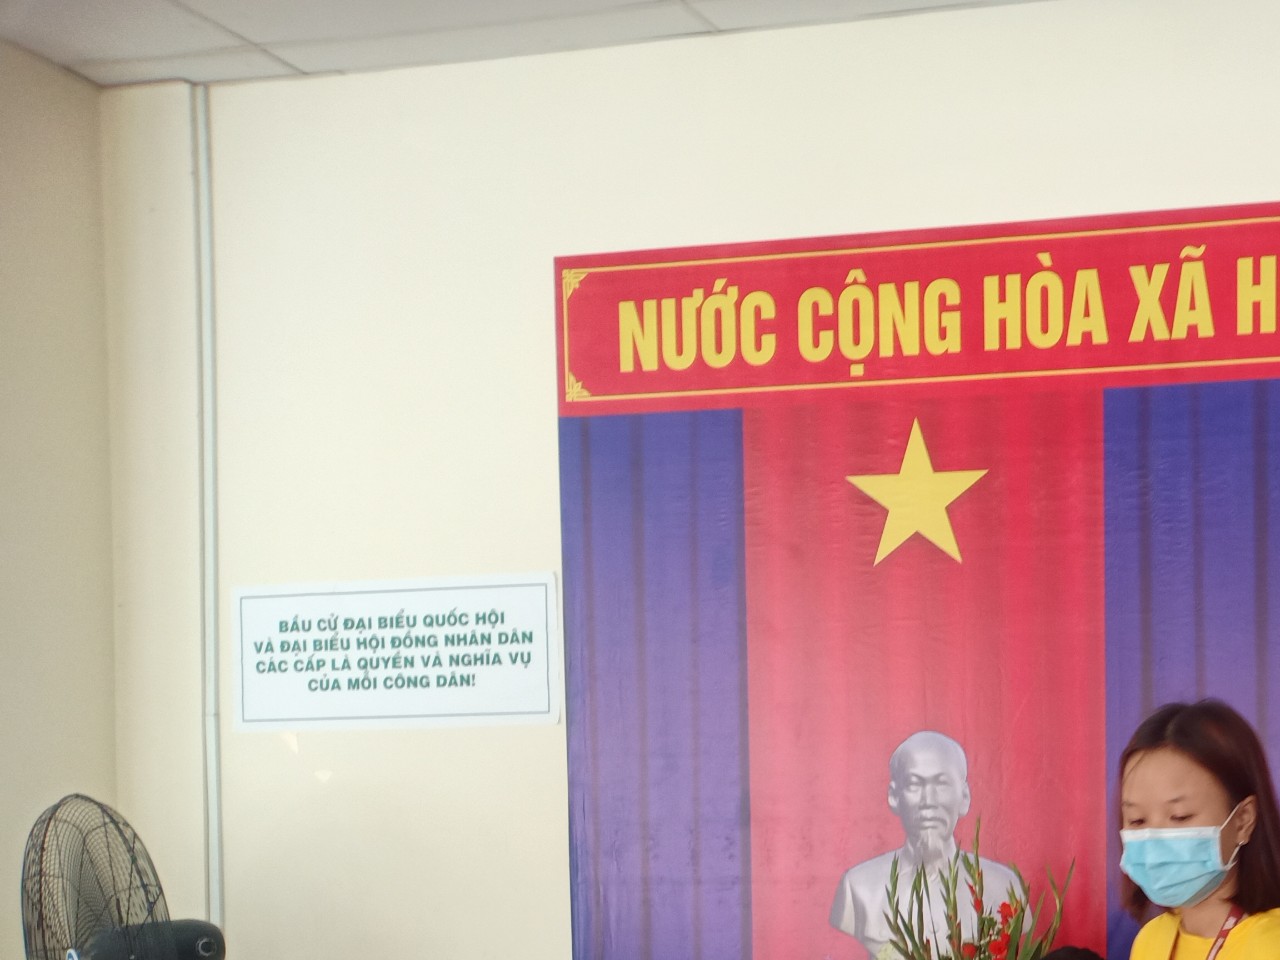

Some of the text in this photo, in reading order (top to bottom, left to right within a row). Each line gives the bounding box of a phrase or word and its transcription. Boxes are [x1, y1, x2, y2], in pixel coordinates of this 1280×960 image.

[618, 277, 776, 373] NƯỚC
[797, 270, 961, 375] CỘNG
[983, 252, 1109, 351] HÒA
[1130, 245, 1215, 341] XÃ
[343, 617, 372, 634] ĐẠI
[423, 607, 469, 628] QUỐC
[475, 608, 505, 629] HỘI
[254, 637, 274, 653] VÀ
[280, 638, 307, 656] ĐẠI
[356, 634, 385, 654] HỘI
[445, 629, 491, 646] NHÂN
[498, 628, 533, 645] DÂN
[256, 657, 288, 673] CÁC
[294, 654, 326, 672] CẤP
[331, 654, 351, 671] LÀ
[421, 651, 442, 668] VÀ
[449, 648, 503, 667] NGHĨA
[509, 651, 531, 668] VỤ
[308, 673, 341, 691] CỦA
[383, 673, 430, 689] CÔNG
